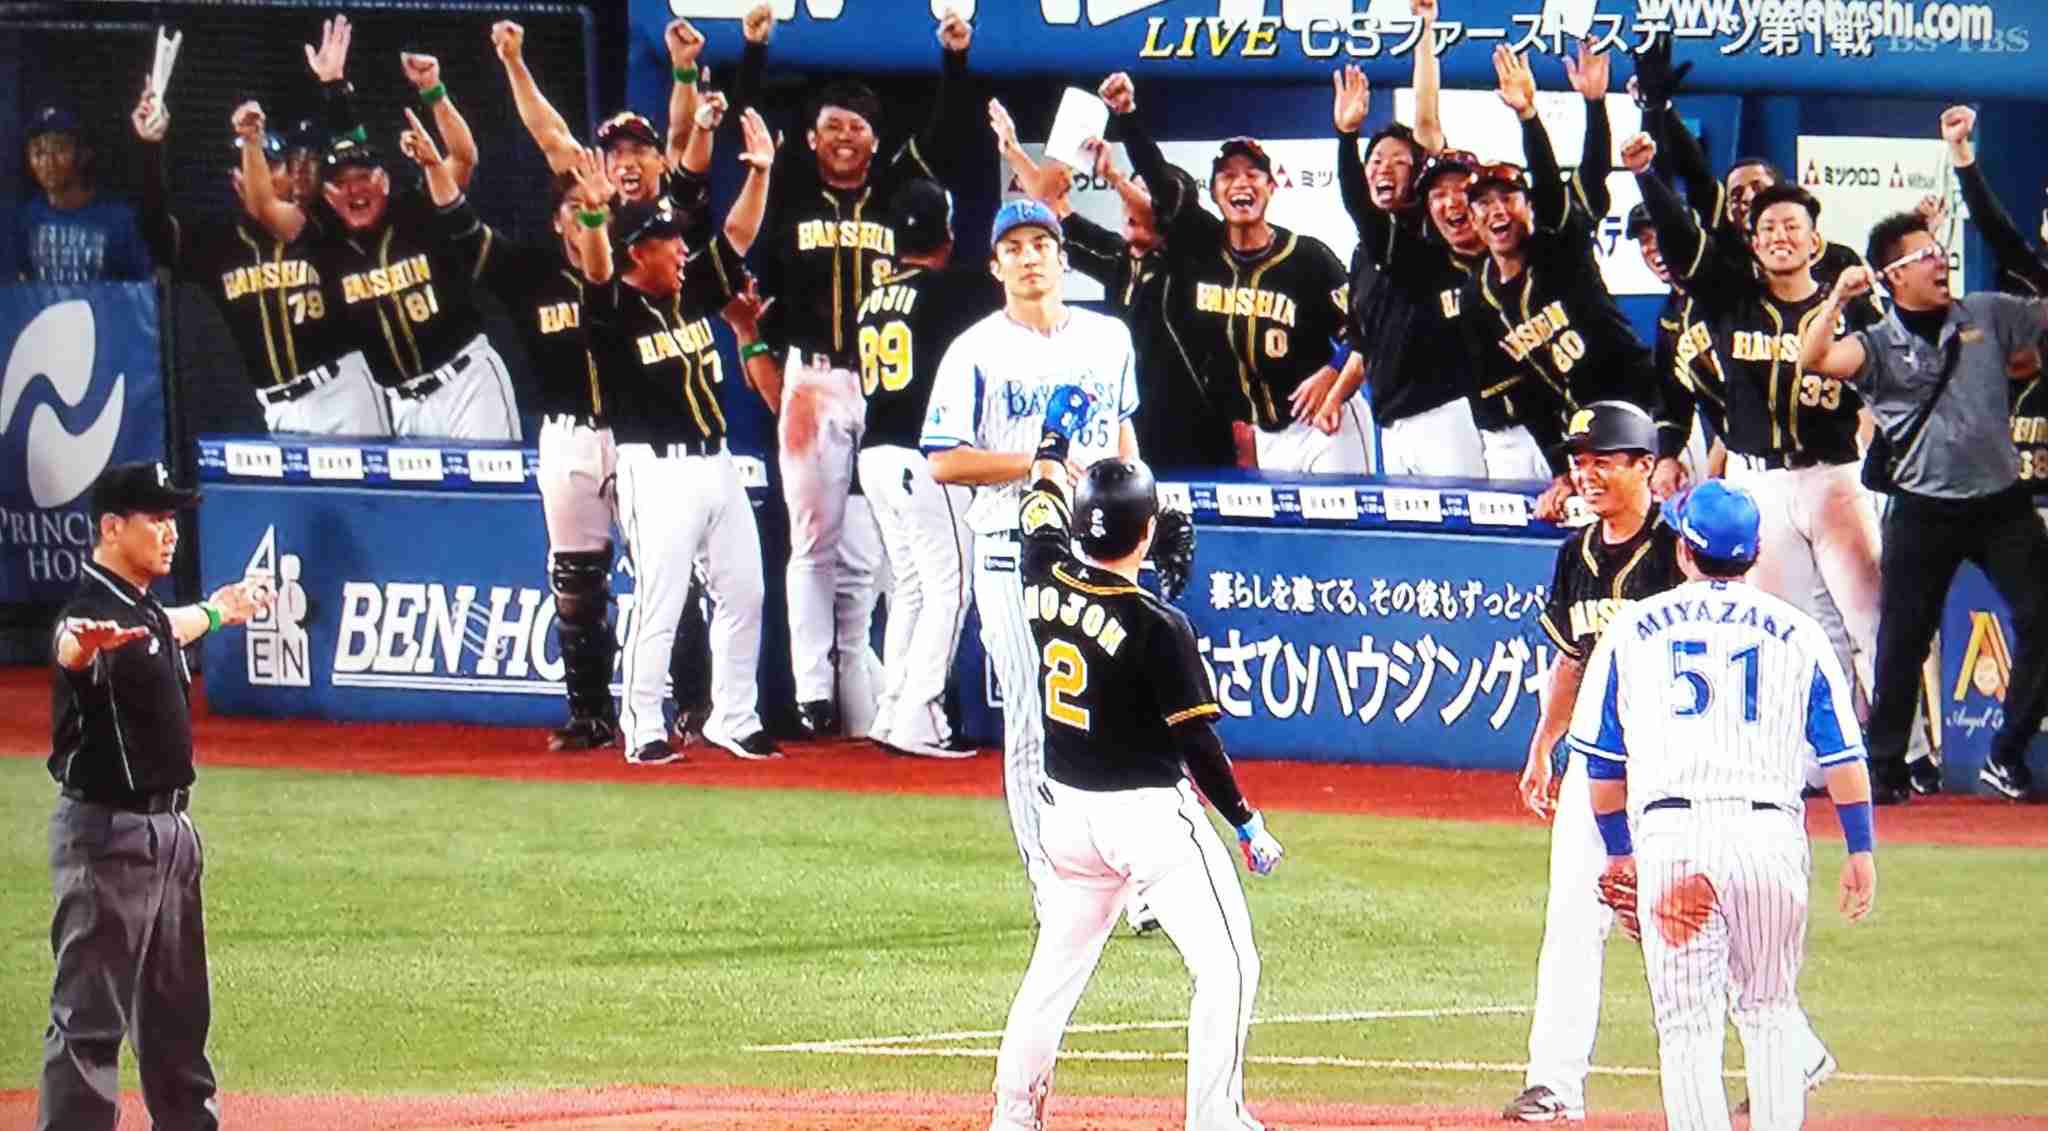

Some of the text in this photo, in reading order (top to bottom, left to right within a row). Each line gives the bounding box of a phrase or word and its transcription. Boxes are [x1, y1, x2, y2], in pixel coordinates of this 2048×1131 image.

[1301, 169, 1334, 188] ミツ
[1196, 282, 1297, 328] HANSHIN
[858, 320, 913, 396] 89
[1265, 328, 1288, 358] 0
[1800, 374, 1842, 411] 33
[0, 507, 97, 545] PRINC
[333, 581, 477, 675] BEN
[1636, 599, 1797, 643] MIYAZAKI
[1043, 638, 1090, 732] 2
[1670, 639, 1762, 724] 51
